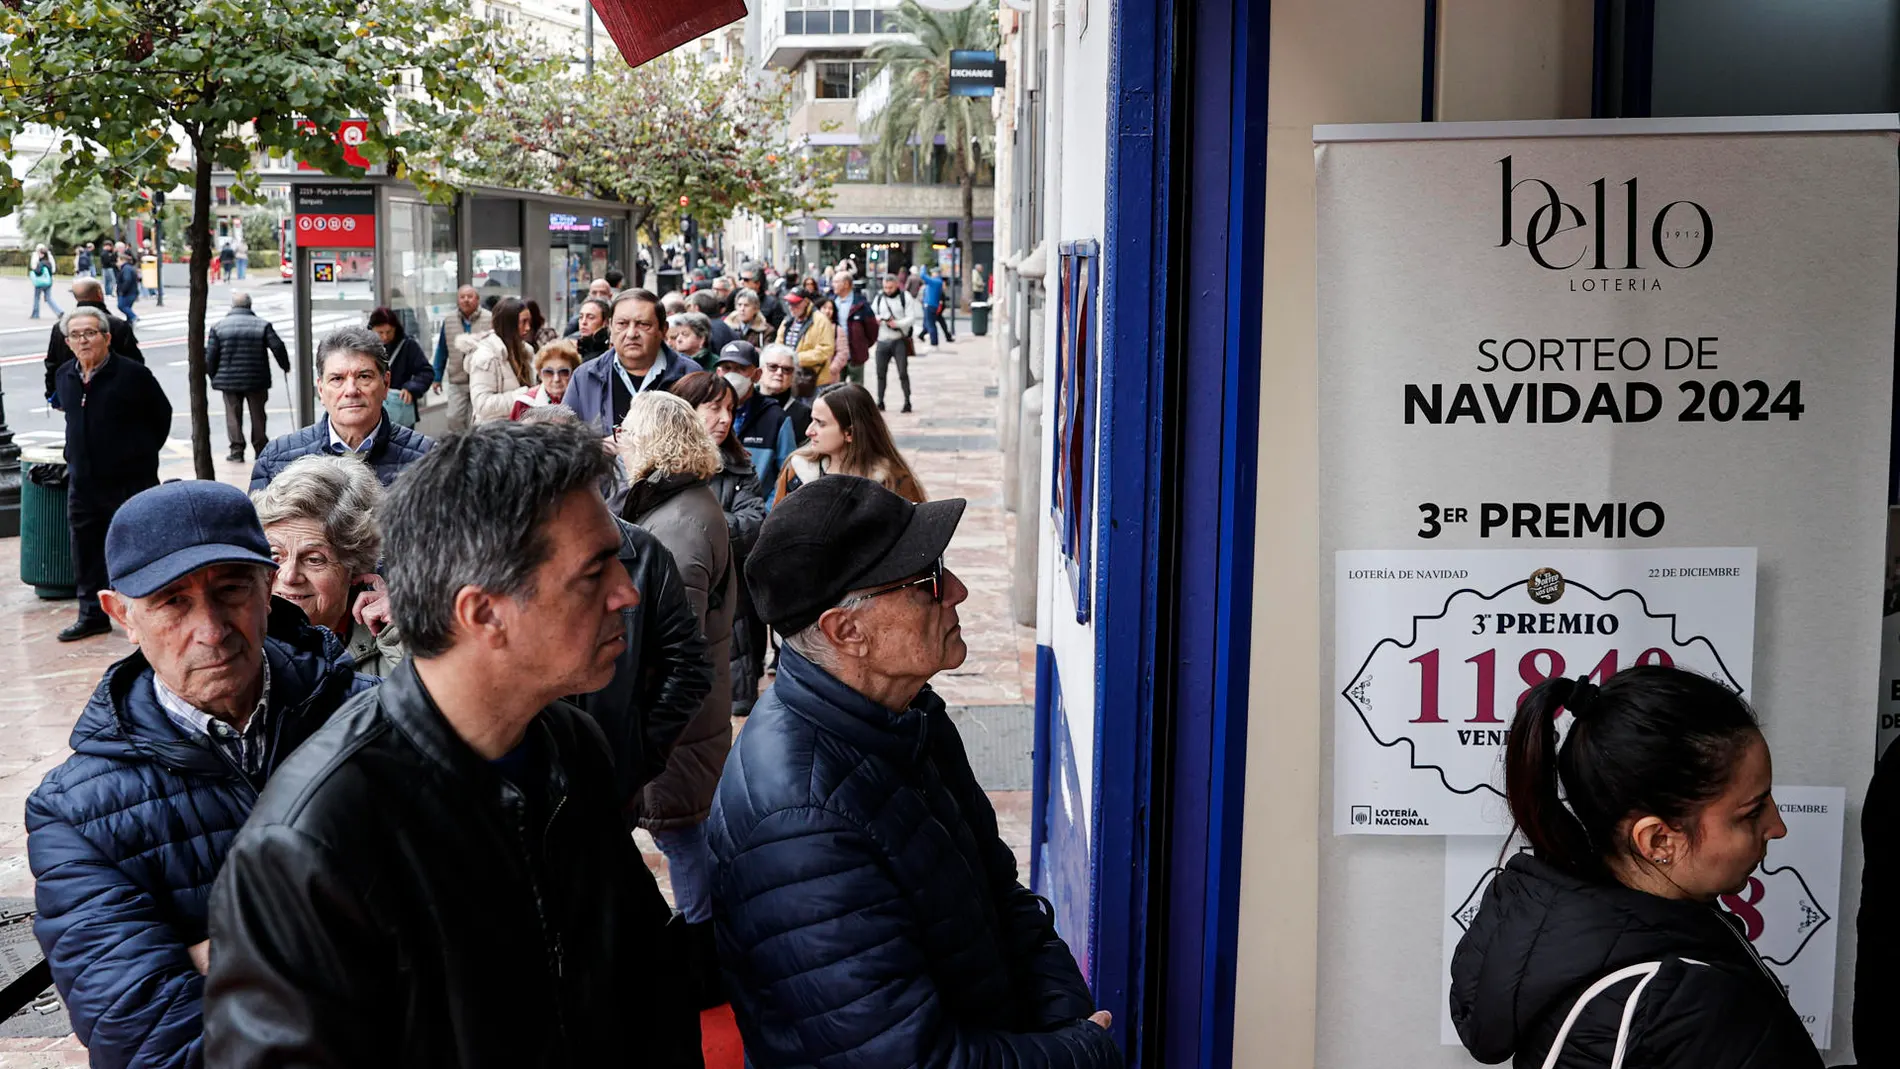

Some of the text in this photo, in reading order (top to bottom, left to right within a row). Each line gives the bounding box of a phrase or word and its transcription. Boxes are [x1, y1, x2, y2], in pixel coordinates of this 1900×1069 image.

[951, 69, 993, 77] EXCHANGE
[1494, 155, 1713, 270] bello
[837, 223, 885, 234] TACO
[1665, 231, 1700, 239] 1912
[1569, 278, 1662, 291] LOTERIA
[1477, 337, 1718, 372] SORTEO DE
[1404, 380, 1805, 424] NAVIDAD 2024
[1480, 502, 1665, 538] PREMIO
[1348, 568, 1469, 579] LOTERÍA DE NAVIDAD
[1648, 567, 1740, 578] 22 DE DICIEMBRE
[1496, 613, 1619, 635] PREMIO
[1375, 808, 1418, 817] LOTERÍA
[1375, 818, 1429, 826] NACIONAL
